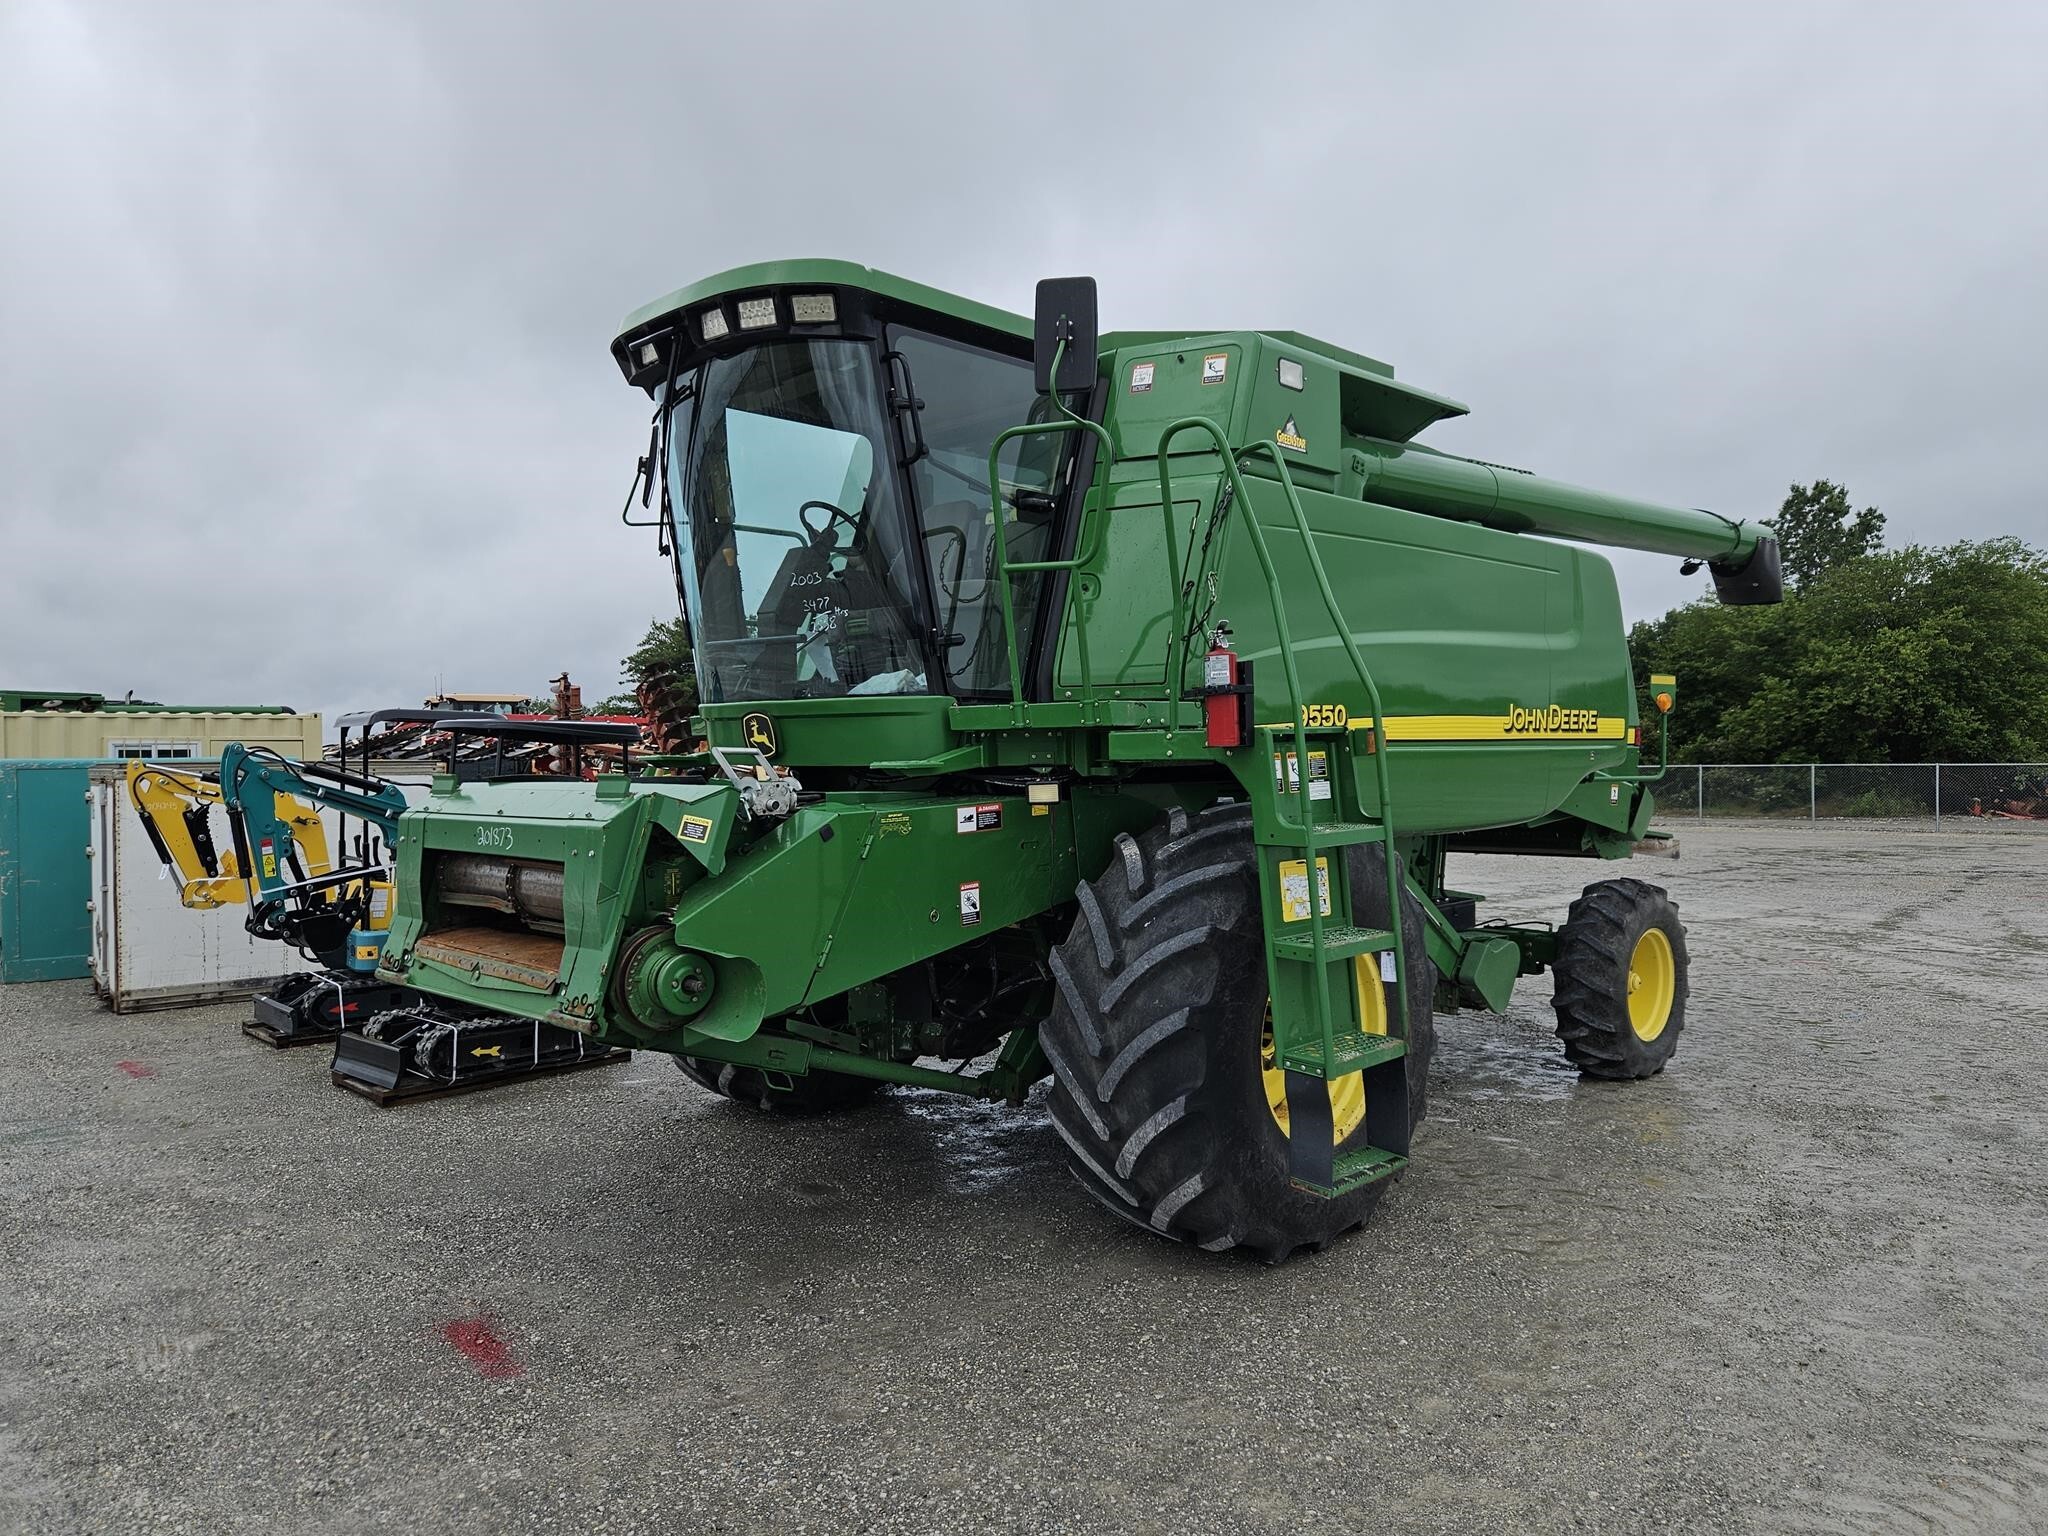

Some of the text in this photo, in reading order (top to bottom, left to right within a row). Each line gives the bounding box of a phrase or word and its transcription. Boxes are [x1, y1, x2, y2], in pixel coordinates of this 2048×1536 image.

[790, 571, 822, 587] 2003
[803, 596, 830, 612] 3477
[476, 825, 514, 851] 201873
